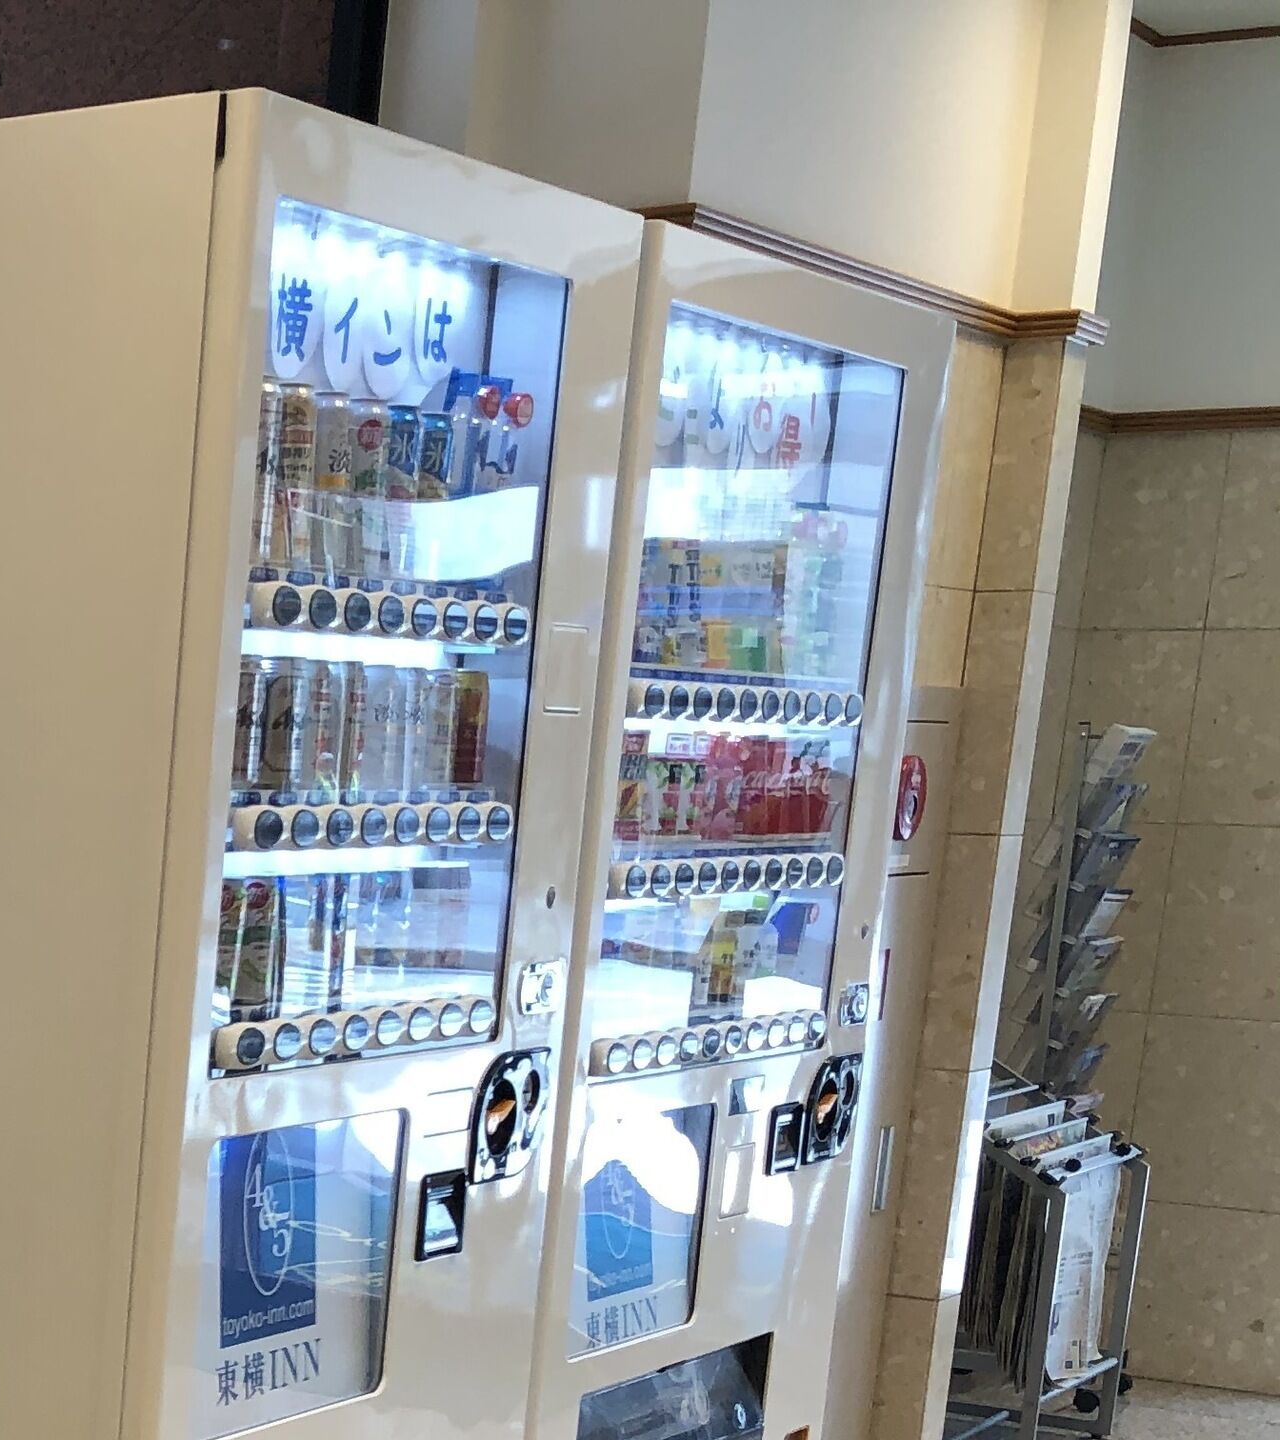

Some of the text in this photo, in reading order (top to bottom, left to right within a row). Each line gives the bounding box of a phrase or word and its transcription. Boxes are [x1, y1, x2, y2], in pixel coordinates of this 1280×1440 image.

[223, 1299, 315, 1339] toyoko-inn.com
[585, 1295, 659, 1349] 東横INN
[215, 1338, 322, 1406] 東横INN
